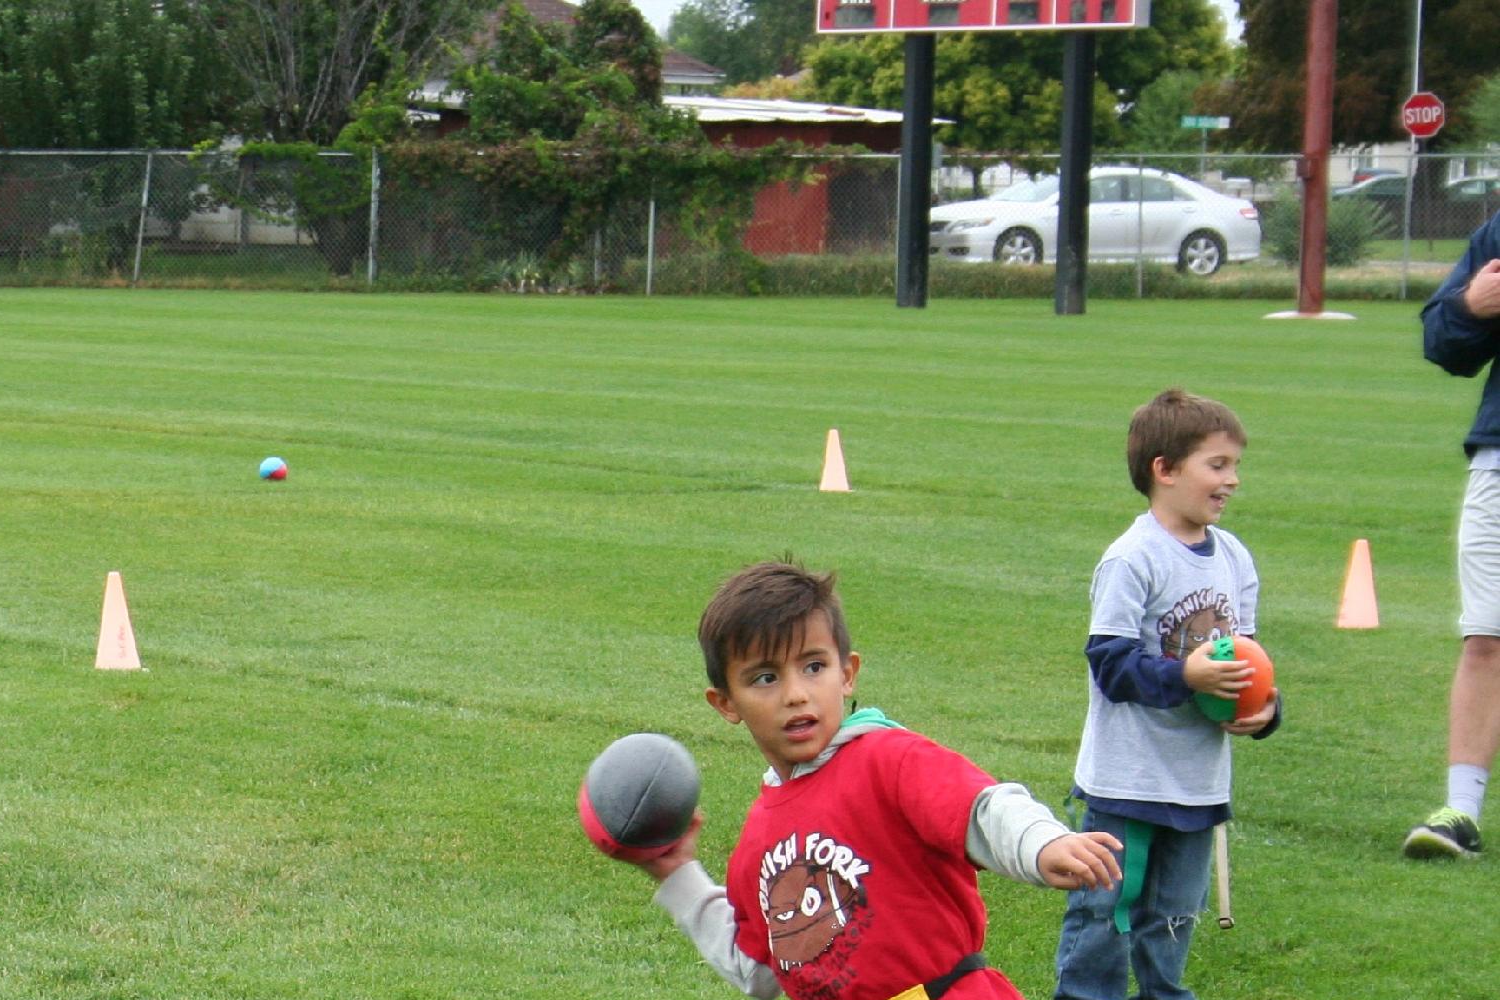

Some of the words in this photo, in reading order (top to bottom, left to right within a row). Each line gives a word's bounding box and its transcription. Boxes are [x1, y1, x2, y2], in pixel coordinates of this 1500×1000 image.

[1405, 106, 1441, 124] STOP
[1158, 586, 1214, 636] SPANISH
[804, 831, 870, 890] FORK
